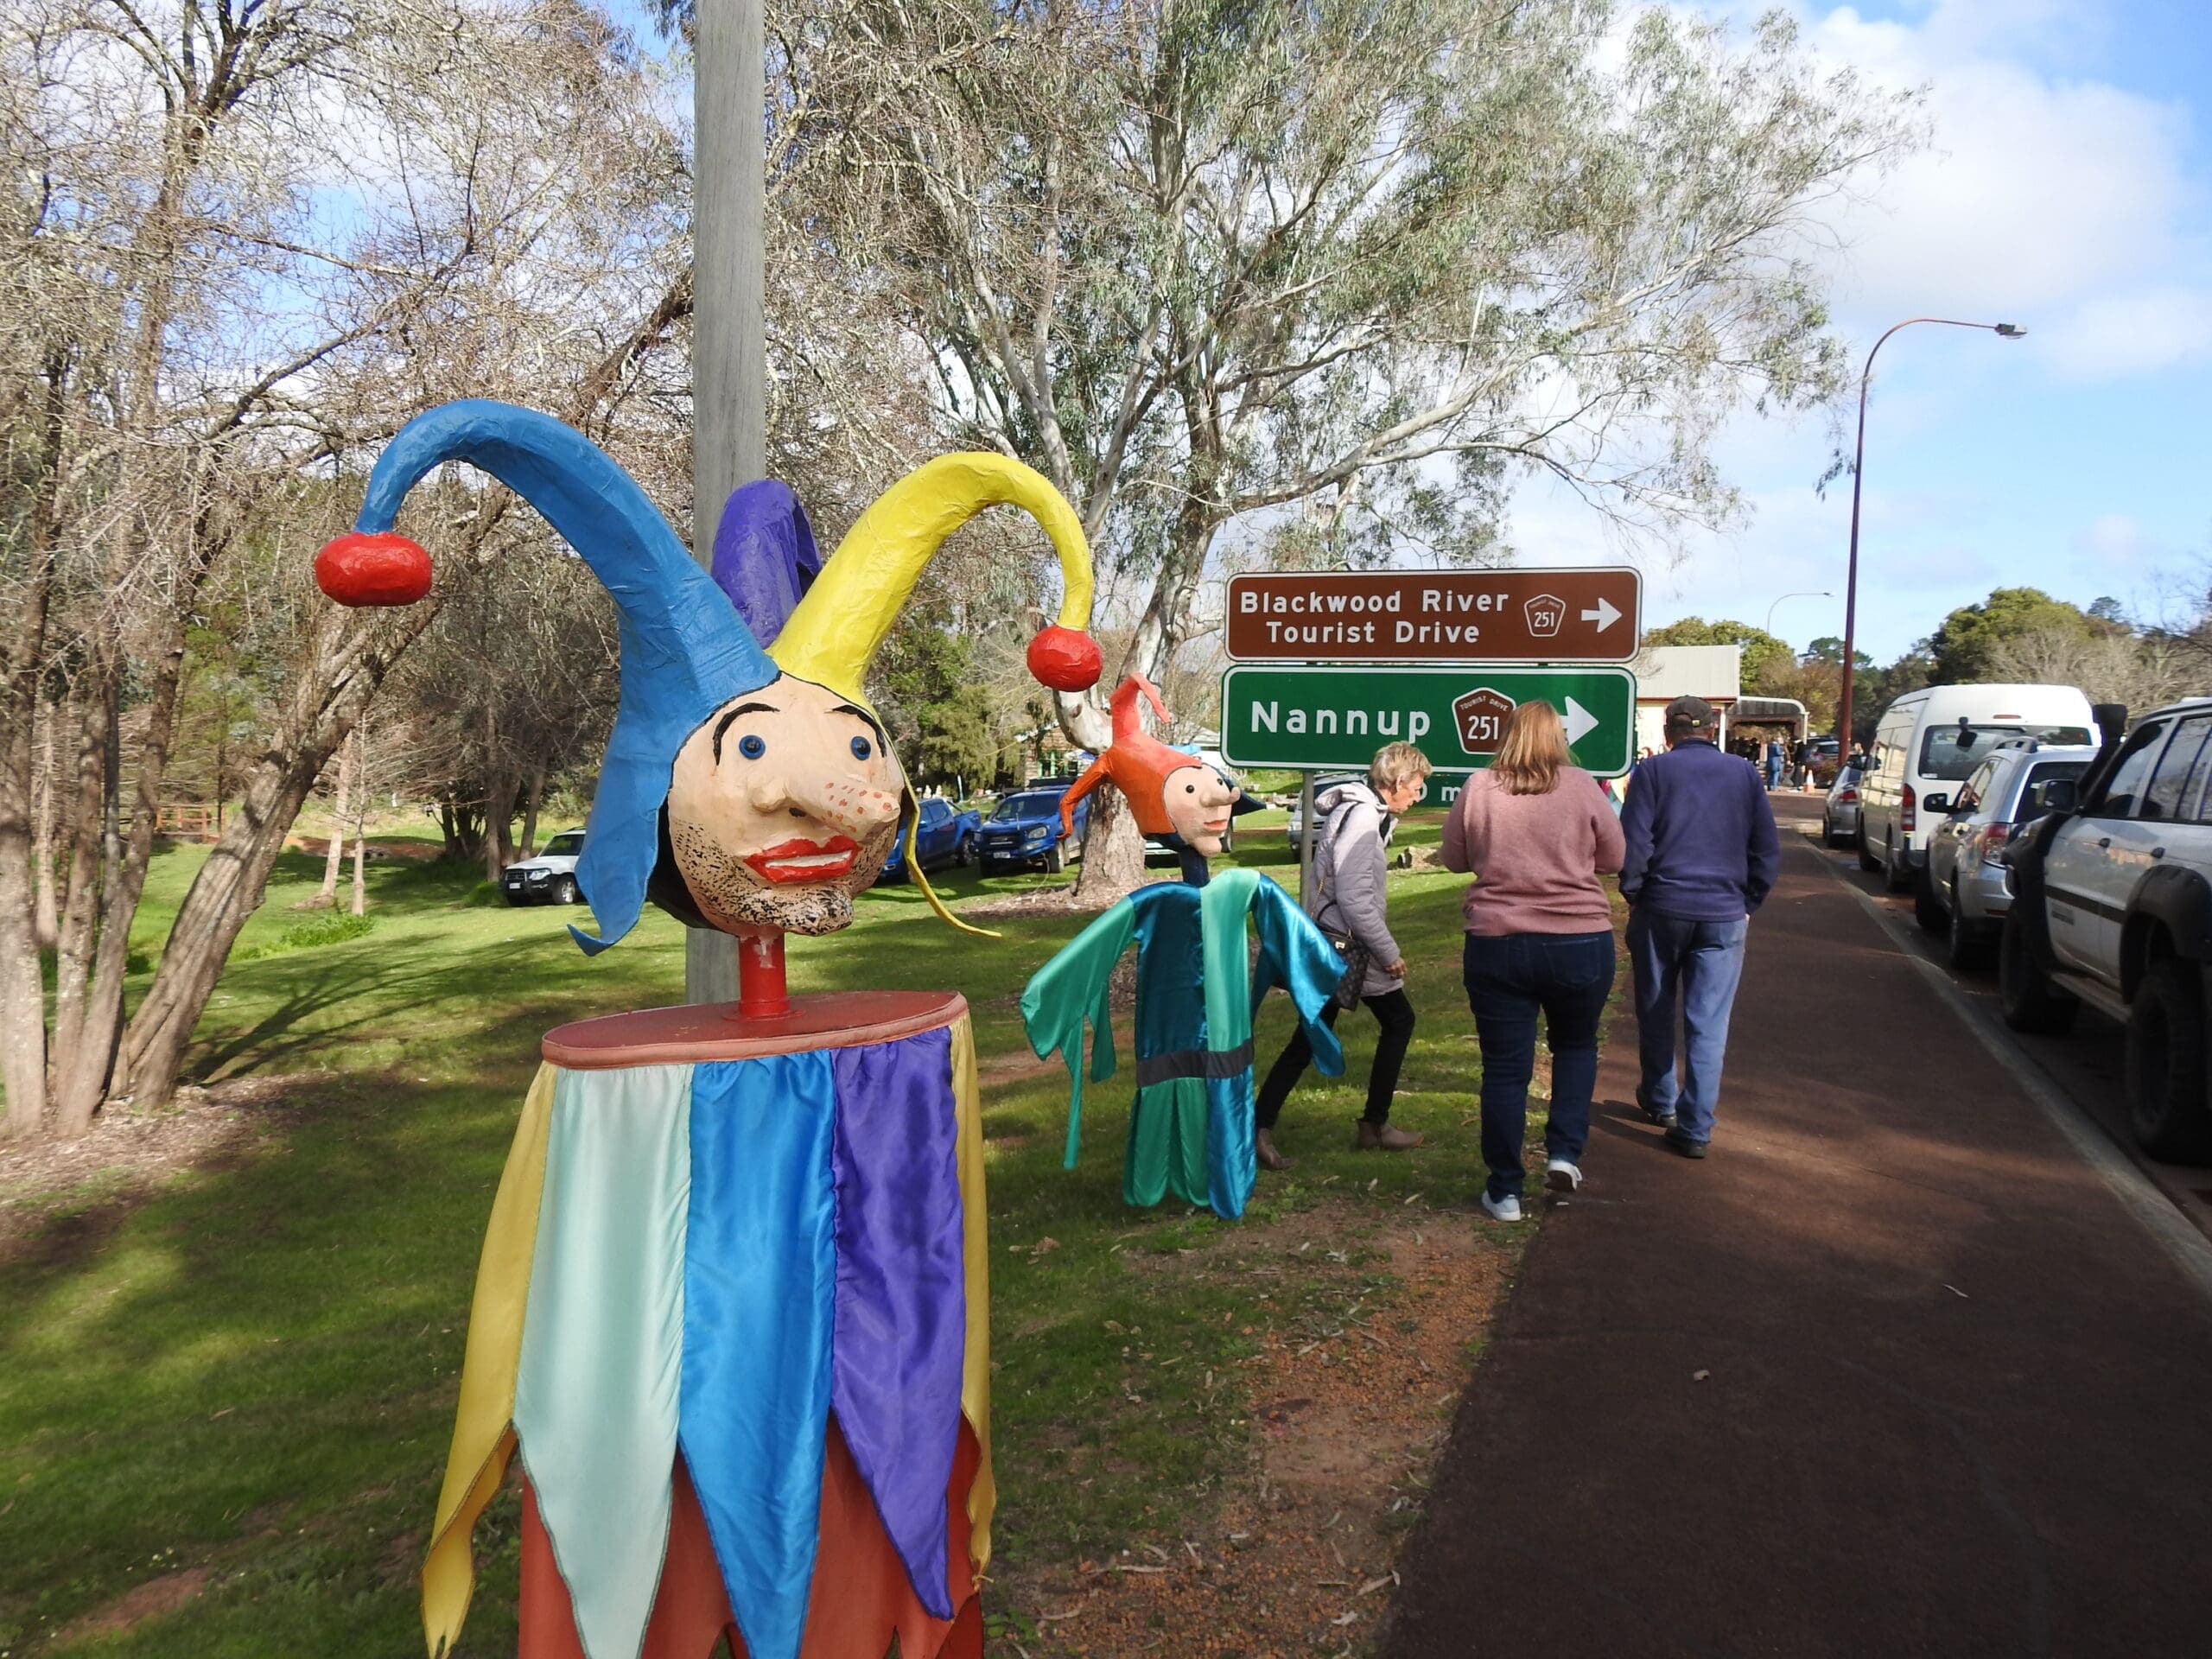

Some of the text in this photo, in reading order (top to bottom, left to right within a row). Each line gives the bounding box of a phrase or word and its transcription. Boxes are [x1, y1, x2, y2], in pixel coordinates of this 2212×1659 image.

[1241, 591, 1401, 613] Blackwood
[1422, 589, 1509, 612] River
[1535, 612, 1554, 627] 251
[1266, 620, 1479, 643] Tourist Drive
[1459, 696, 1509, 711] TOURIST DRIVE
[1251, 701, 1430, 744] Nannup
[1467, 715, 1499, 740] 251
